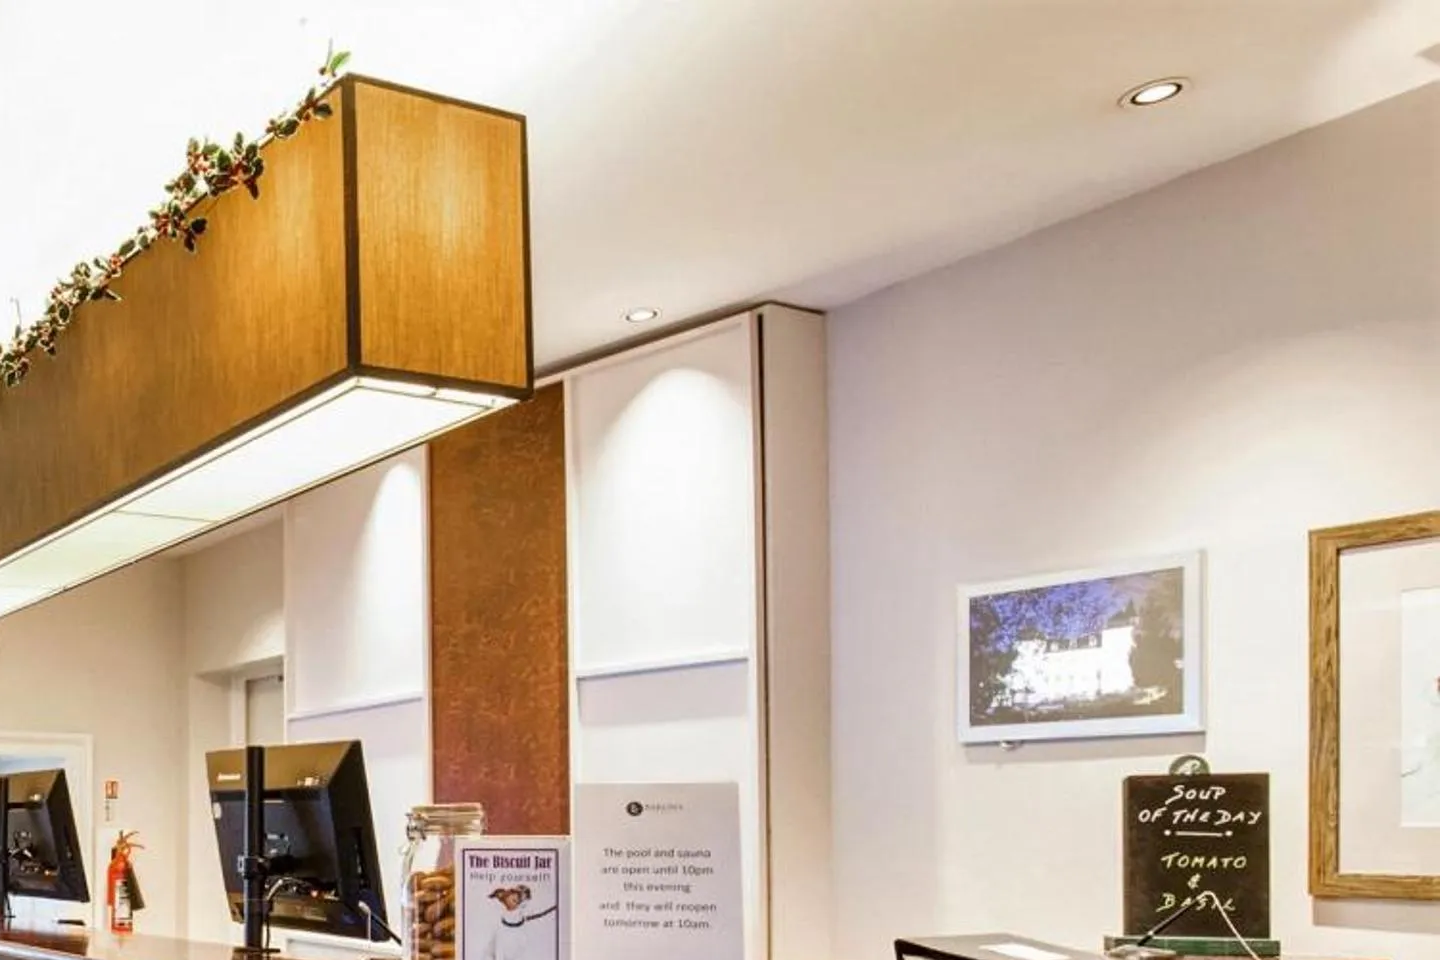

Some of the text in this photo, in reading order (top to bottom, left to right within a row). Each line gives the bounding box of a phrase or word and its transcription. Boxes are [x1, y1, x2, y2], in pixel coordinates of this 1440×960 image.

[1165, 784, 1227, 805] SOUP
[1138, 806, 1168, 823] OF
[1213, 809, 1262, 826] DAY
[603, 848, 712, 859] The pool and sauna
[469, 855, 552, 870] The Biscuit Jar
[1161, 852, 1247, 869] TOMATO
[602, 865, 714, 877] are open until 10pm
[623, 882, 691, 894] this evening
[675, 902, 717, 914] reopen
[604, 918, 659, 928] tomorrow
[661, 919, 673, 928] at
